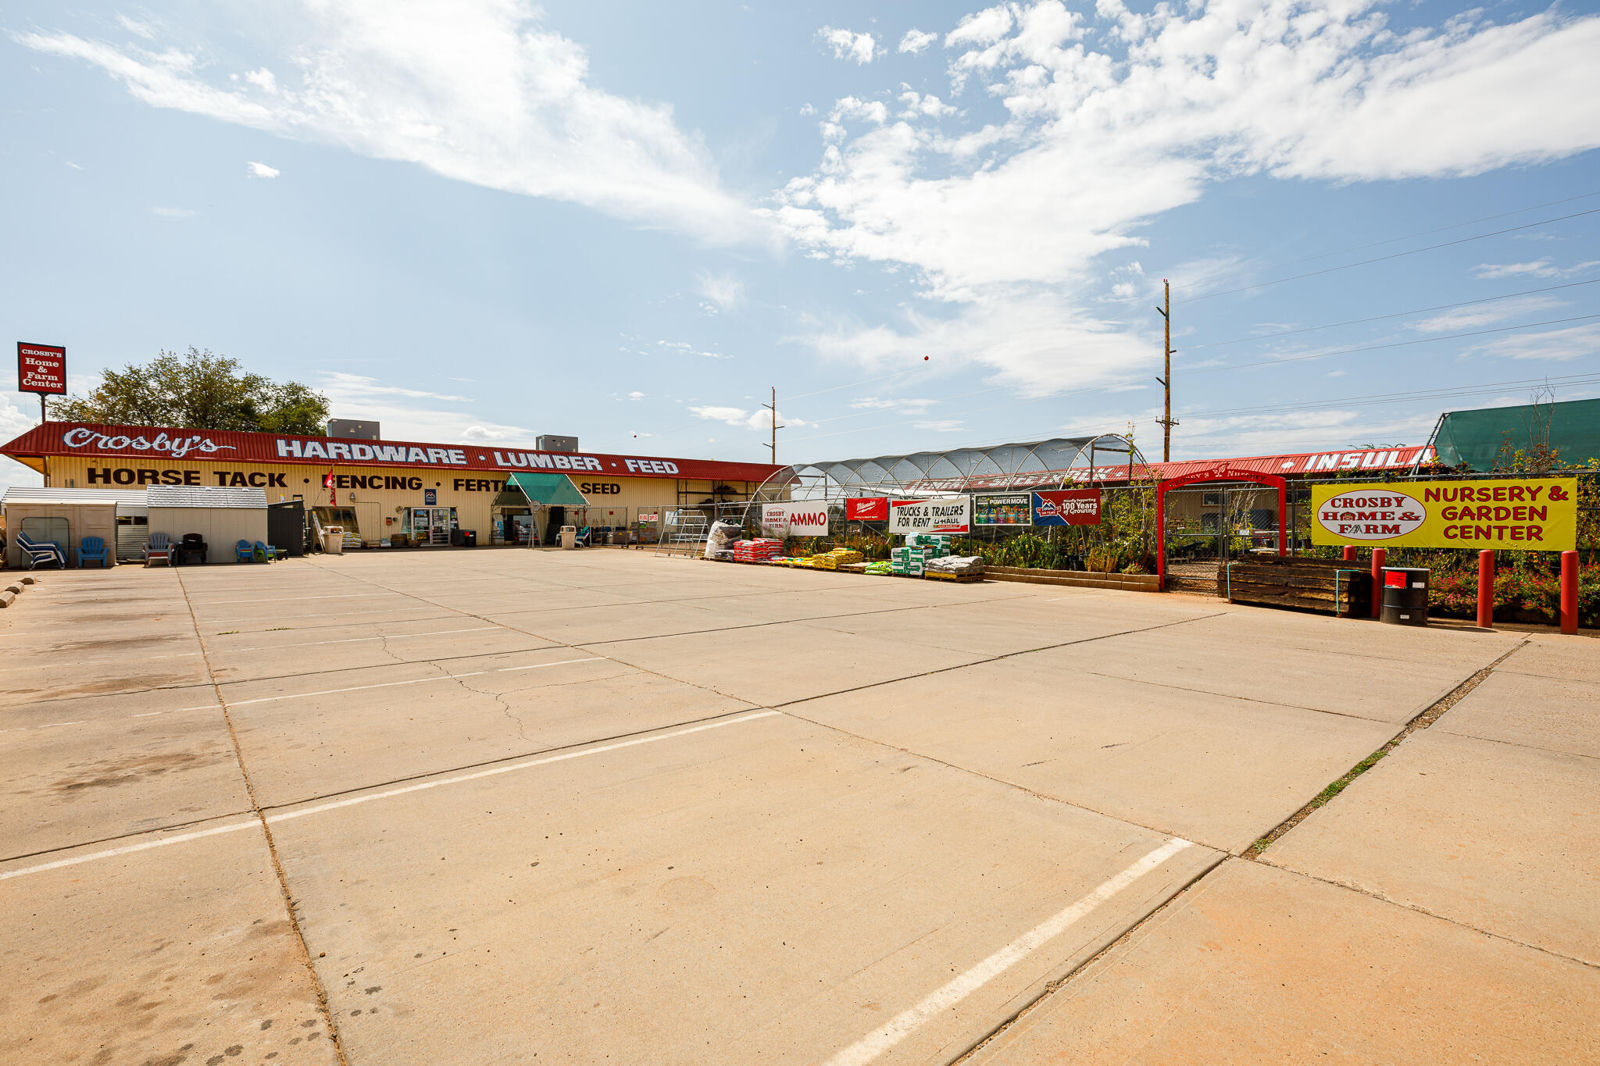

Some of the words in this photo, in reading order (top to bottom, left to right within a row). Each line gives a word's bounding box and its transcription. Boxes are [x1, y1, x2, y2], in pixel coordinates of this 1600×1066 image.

[21, 349, 61, 358] CROSBY'S
[25, 357, 59, 367] Home
[37, 365, 47, 373] &
[27, 371, 58, 380] Farm
[22, 378, 63, 388] Center
[62, 427, 236, 458] Crosby's
[276, 439, 467, 465] HARDWARE
[492, 450, 603, 472] LUMBER
[624, 458, 680, 475] FEED
[87, 467, 201, 486] HORSE
[213, 471, 288, 488] TACK
[321, 474, 423, 491] FENCING
[580, 482, 621, 495] SEED
[1424, 486, 1543, 503] NURSERY
[1548, 485, 1568, 501] &
[1330, 497, 1406, 509] CROSBY
[896, 506, 921, 517] TRUCKS
[923, 506, 929, 517] &
[931, 505, 964, 516] TRAILERS
[1321, 511, 1396, 522] HOME
[1400, 511, 1421, 522] &
[1441, 505, 1548, 522] GARDEN
[789, 512, 827, 526] AMMO
[897, 517, 910, 527] FOR
[912, 518, 931, 527] RENT
[1338, 523, 1402, 535] FARM
[1443, 524, 1544, 542] CENTER
